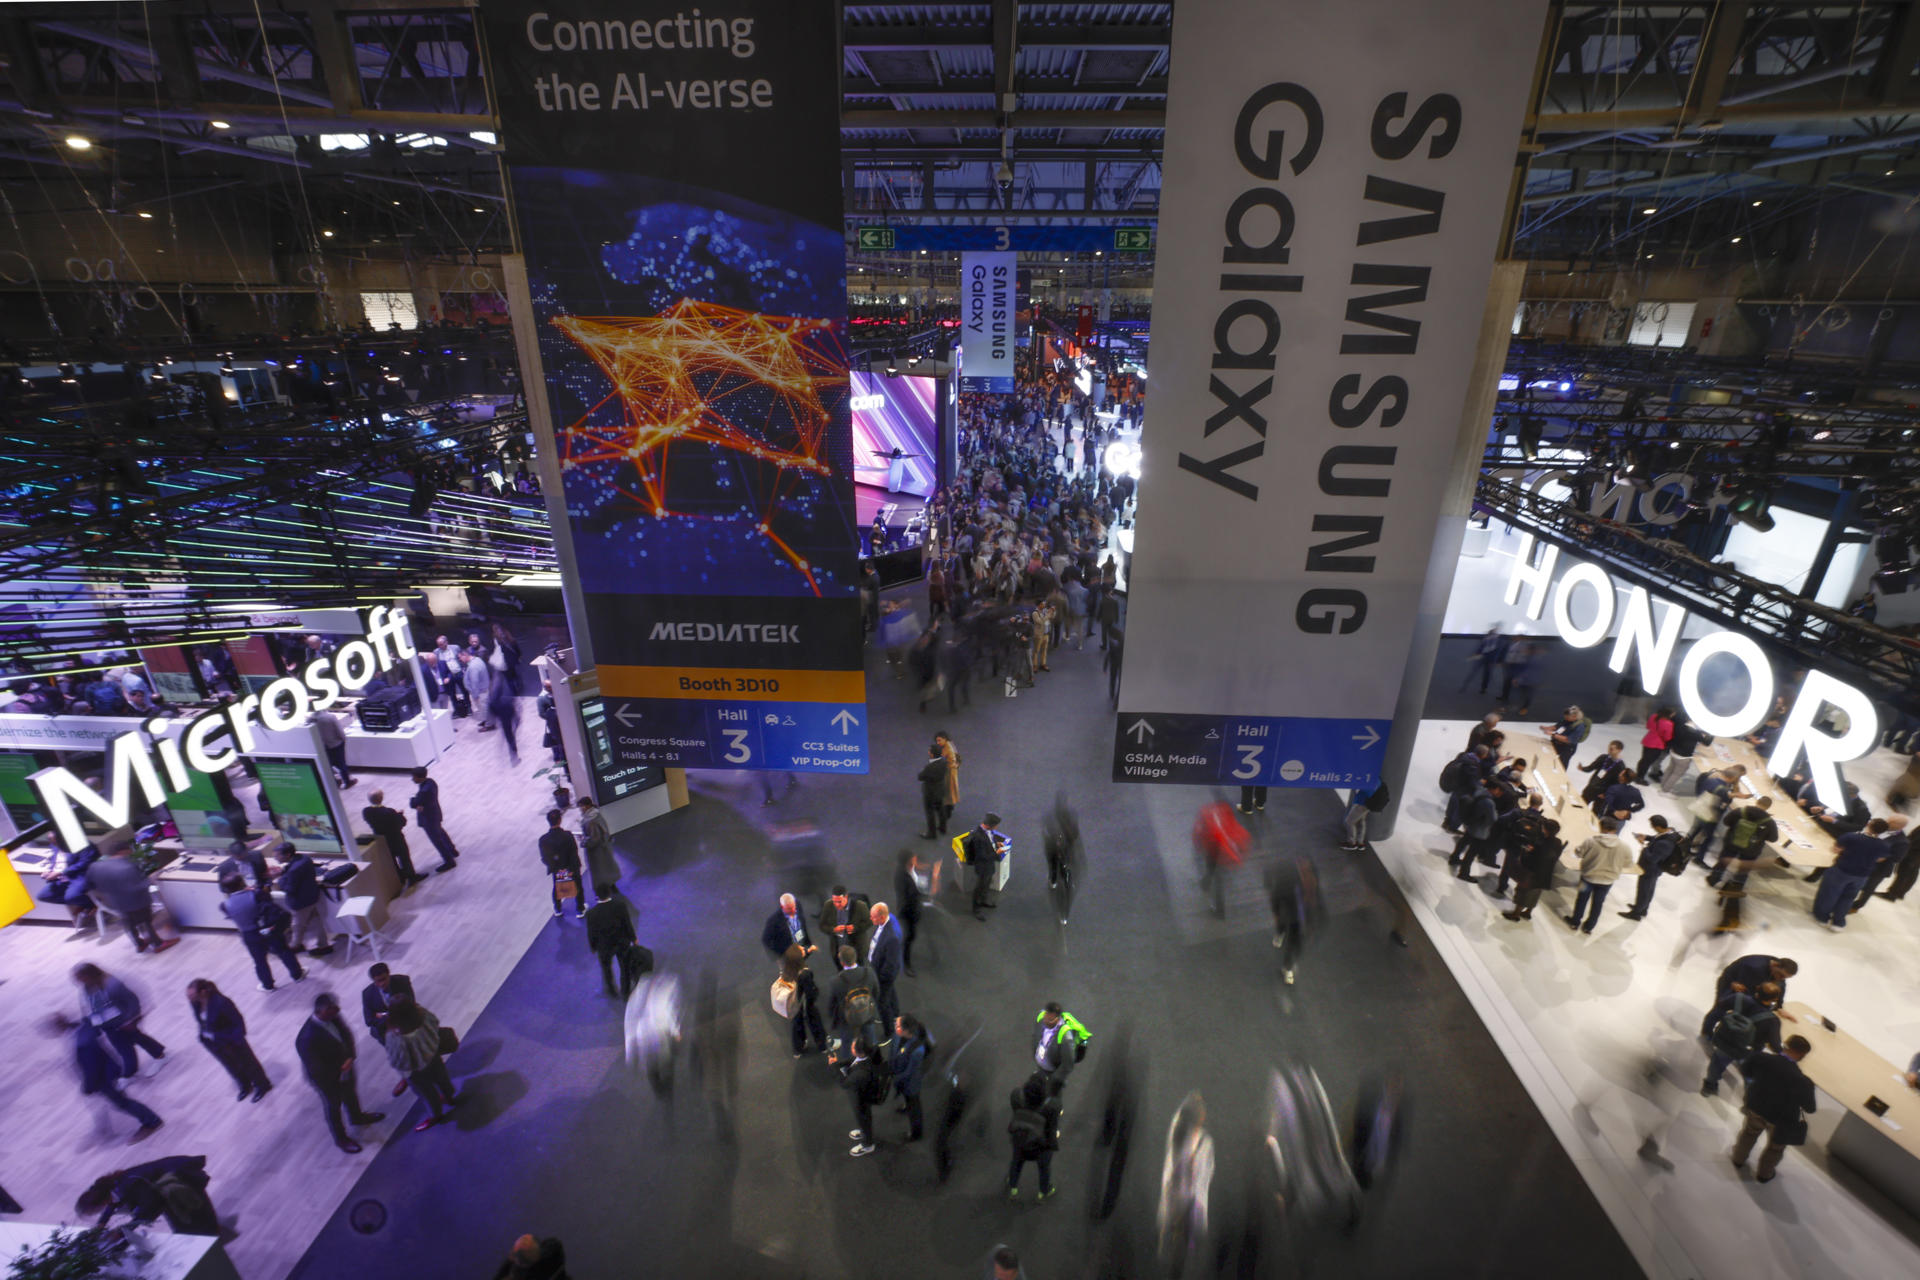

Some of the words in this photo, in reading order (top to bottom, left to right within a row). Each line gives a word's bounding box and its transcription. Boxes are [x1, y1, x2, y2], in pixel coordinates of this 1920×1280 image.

[526, 8, 756, 58] Connecting
[534, 73, 601, 111] the
[611, 72, 774, 110] AI-verse
[994, 226, 1010, 251] 3
[968, 264, 986, 333] Galaxy
[1178, 81, 1324, 502] Galaxy
[992, 266, 1007, 360] SAMSUNG
[1295, 91, 1462, 635] SAMSUNG
[983, 382, 991, 392] 3
[649, 622, 801, 643] MEDIATEK
[1504, 532, 1879, 816] HONOR
[678, 676, 732, 692] Booth
[735, 678, 780, 692] 3D10
[717, 709, 748, 721] Hall
[26, 604, 417, 854] Microsoft
[44, 727, 66, 739] the
[1237, 725, 1270, 737] Hall
[618, 736, 667, 747] Congress
[669, 737, 706, 748] Square
[721, 729, 752, 764] 3
[802, 742, 825, 751] CC3
[827, 743, 860, 753] Suites
[621, 751, 647, 760] Halls
[648, 752, 656, 760] 4
[666, 752, 680, 761] 8.1
[792, 756, 811, 766] VIP
[812, 758, 861, 768] Drop-Off
[1125, 753, 1164, 764] GSMA
[1168, 754, 1208, 765] Media
[1231, 744, 1264, 780] 3
[603, 771, 627, 782] Touch
[1124, 765, 1169, 778] Village
[1309, 772, 1341, 782] Halls
[1343, 773, 1352, 783] 2
[1365, 774, 1371, 783] 1
